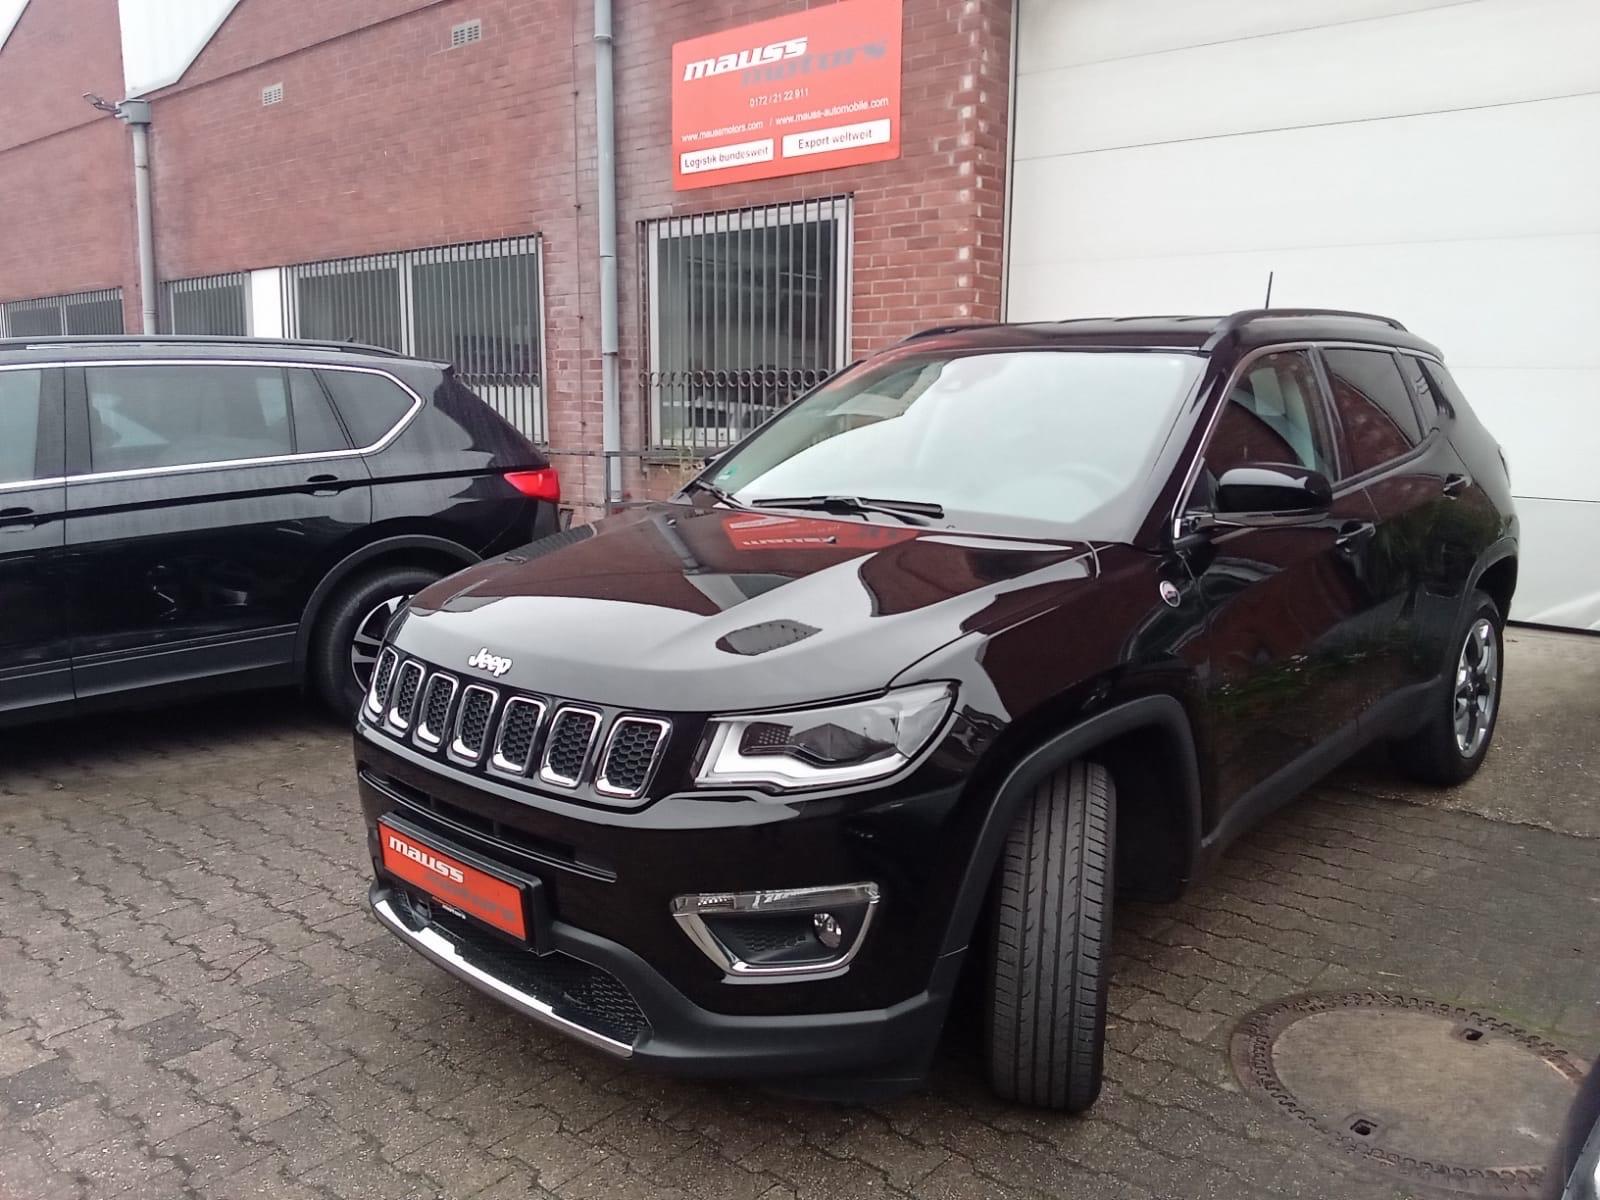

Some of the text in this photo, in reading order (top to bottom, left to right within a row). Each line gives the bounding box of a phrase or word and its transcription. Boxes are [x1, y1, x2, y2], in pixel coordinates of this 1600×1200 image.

[683, 36, 808, 81] mauss
[681, 120, 763, 142] www.maussmotors.com
[776, 97, 889, 126] www.mauss-automobile.com
[683, 147, 769, 169] Logistik bundesweit
[798, 129, 872, 150] Export weltweit
[468, 647, 512, 677] Jeep
[389, 836, 464, 884] mauss
